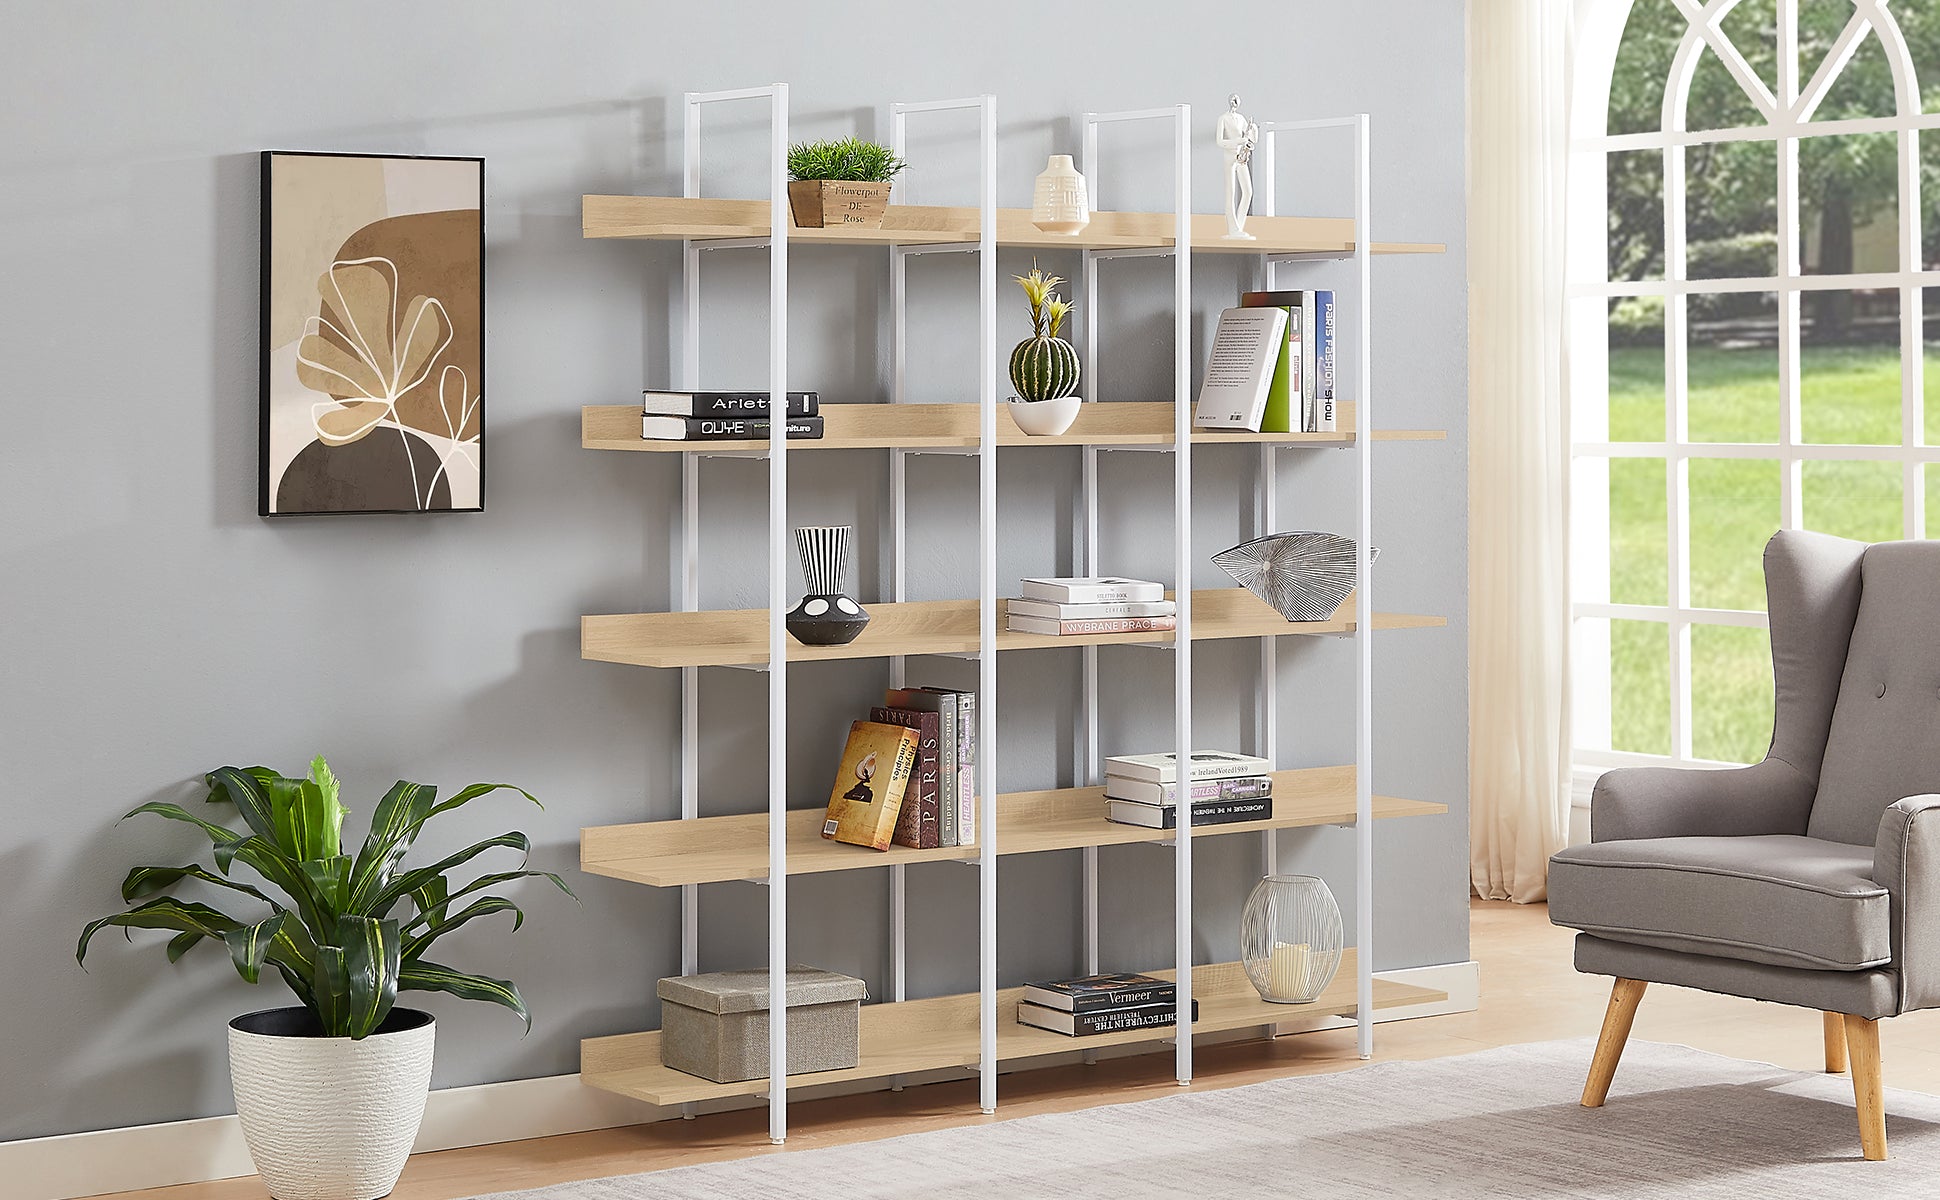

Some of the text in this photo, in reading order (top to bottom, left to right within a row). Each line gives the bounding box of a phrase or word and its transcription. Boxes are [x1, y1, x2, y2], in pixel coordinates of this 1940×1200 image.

[835, 186, 879, 198] Flowerpot
[849, 202, 862, 210] DE
[843, 214, 865, 223] Rose
[1325, 389, 1333, 421] SHOW
[1067, 621, 1118, 632] WYBRANE
[1121, 618, 1157, 630] PRACE
[879, 711, 912, 725] PARIS
[892, 738, 910, 781] Principles
[901, 745, 916, 780] Physics
[923, 738, 936, 823] PARIS
[963, 768, 971, 821] HEARTLESS
[1109, 991, 1151, 1005] Vermeer
